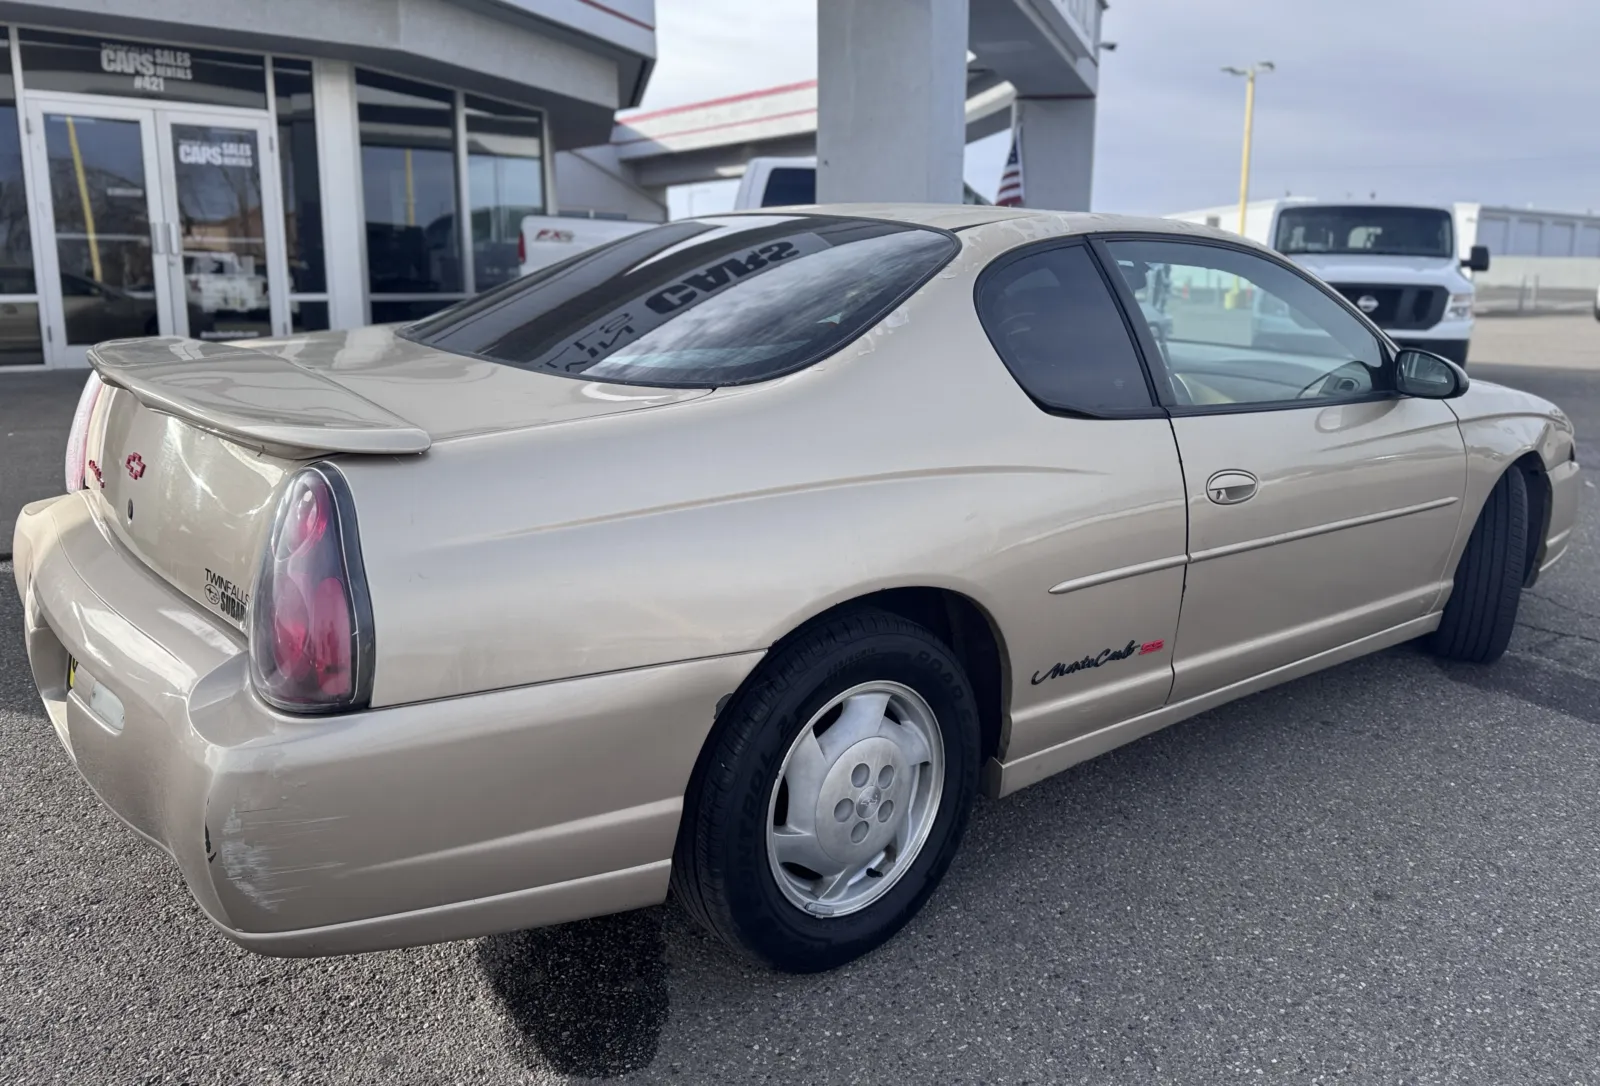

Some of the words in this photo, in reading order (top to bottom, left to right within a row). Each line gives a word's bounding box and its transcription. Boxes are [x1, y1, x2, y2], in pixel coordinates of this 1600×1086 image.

[101, 48, 155, 76] CARS
[155, 49, 191, 68] SALES
[134, 76, 164, 92] #421
[179, 145, 222, 166] CARS
[221, 142, 252, 157] SALES
[221, 591, 247, 622] SUBAR
